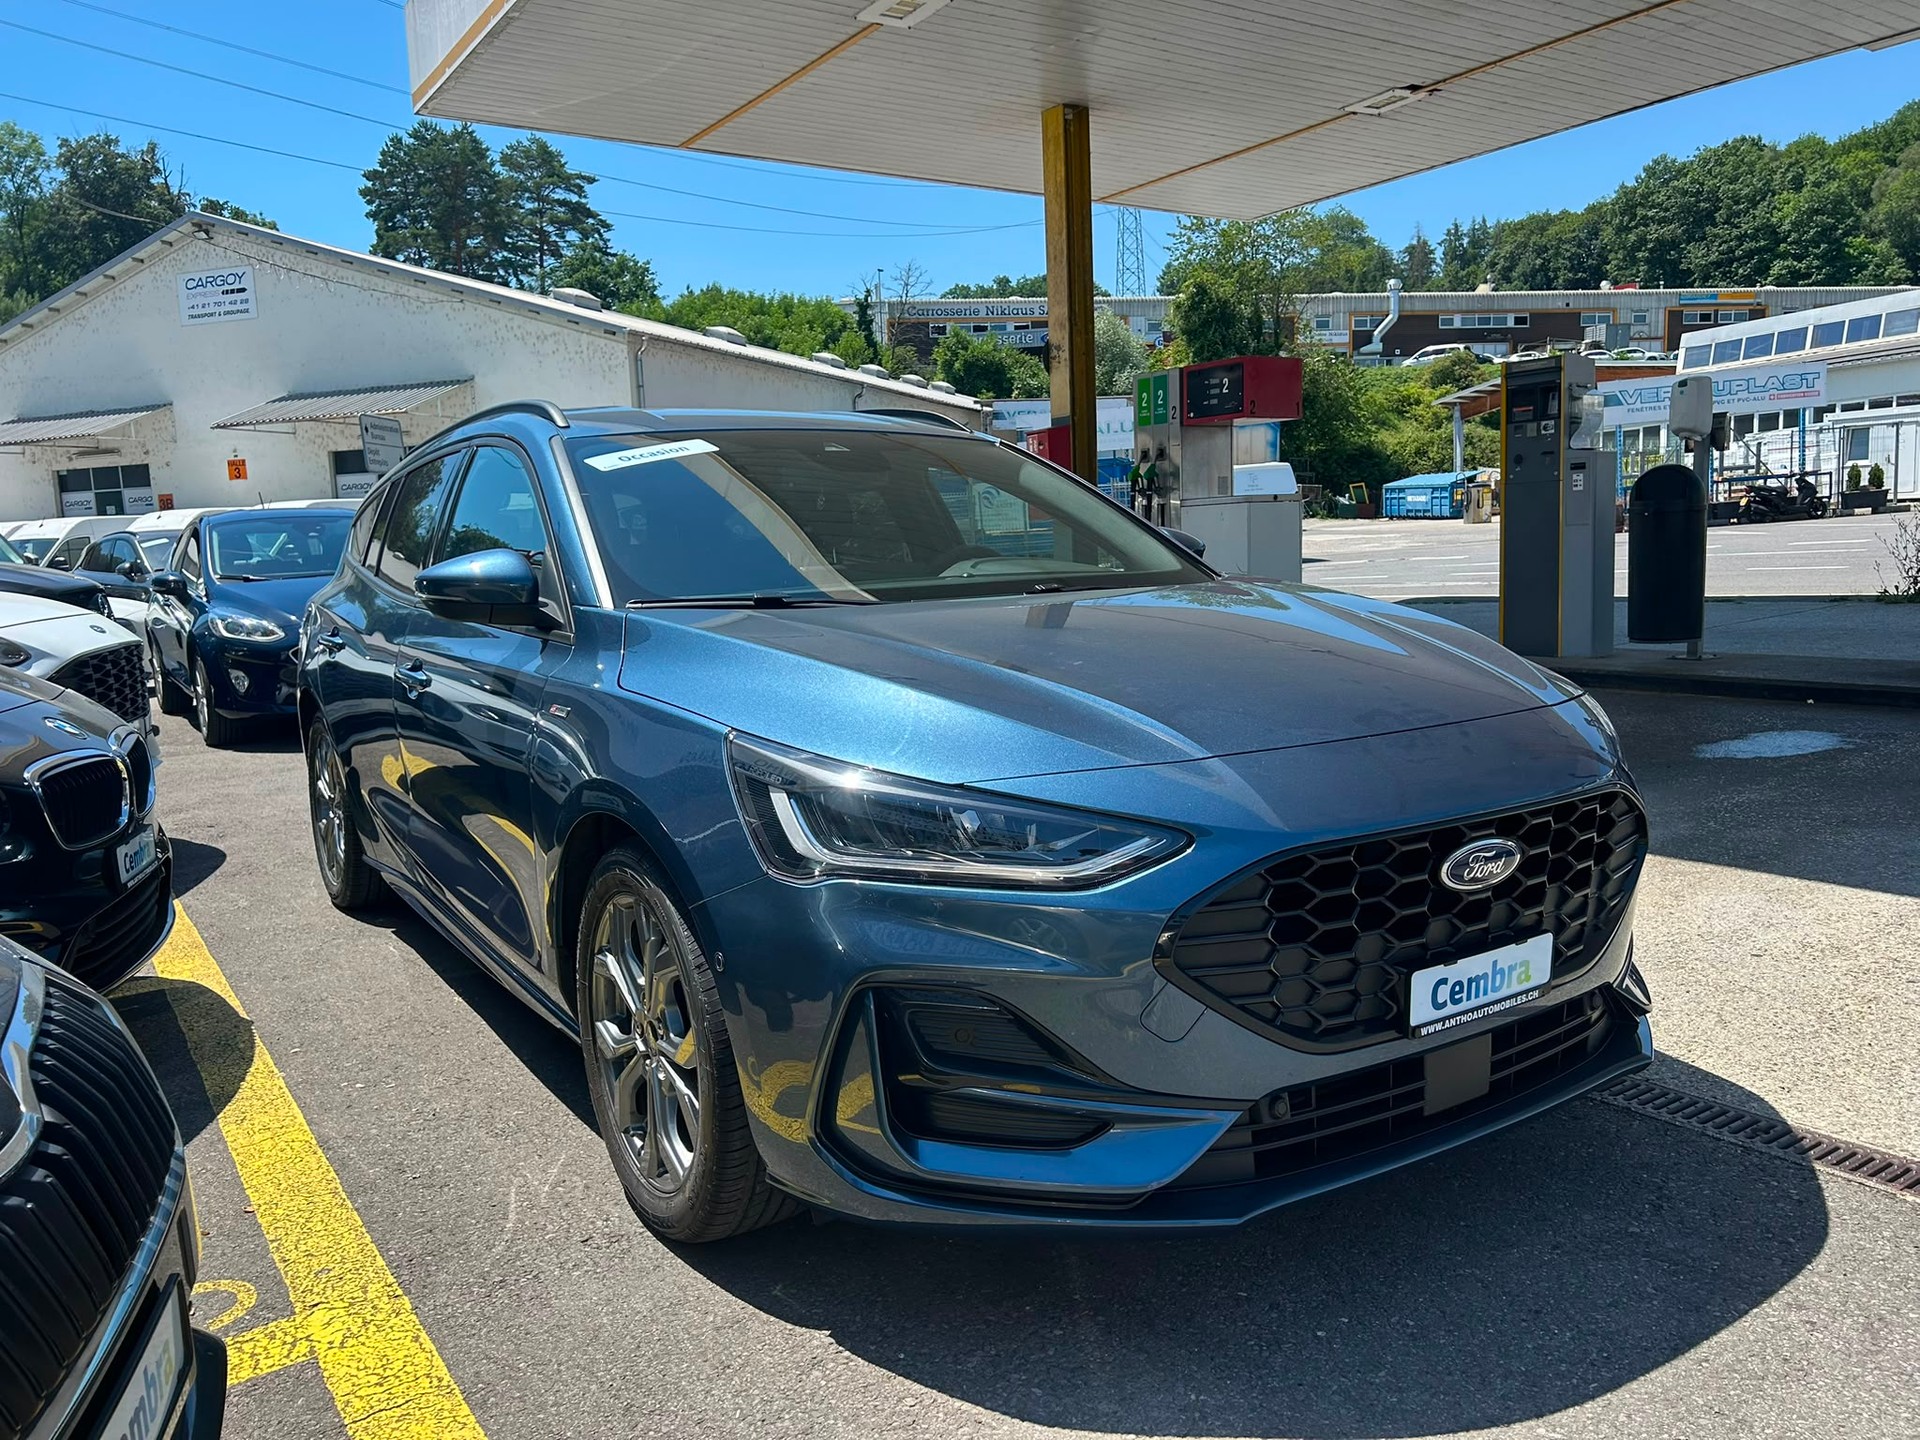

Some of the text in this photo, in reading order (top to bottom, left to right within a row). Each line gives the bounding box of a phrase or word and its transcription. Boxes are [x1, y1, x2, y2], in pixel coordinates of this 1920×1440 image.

[185, 271, 246, 290] CARGOY
[186, 290, 220, 300] EXPRESS
[187, 311, 217, 320] TRANSPORT
[223, 308, 250, 316] GROUPAGE
[906, 305, 981, 317] Carrosserie
[985, 305, 1035, 317] Niklaus
[1222, 377, 1229, 393] 2
[1141, 392, 1148, 407] 2
[1157, 389, 1164, 404] 2
[1171, 405, 1177, 420] 2
[1250, 400, 1256, 414] 2
[618, 445, 690, 462] Occasion
[234, 467, 242, 479] 3
[340, 482, 373, 491] CARGOY
[64, 499, 92, 508] CARGOY
[159, 499, 174, 510] 3B
[1463, 850, 1506, 880] Ford
[1431, 959, 1532, 1011] Cembra
[1420, 990, 1539, 1036] WWW.ANTHOAUTOMOBILES.CH
[119, 1338, 175, 1440] mbra
